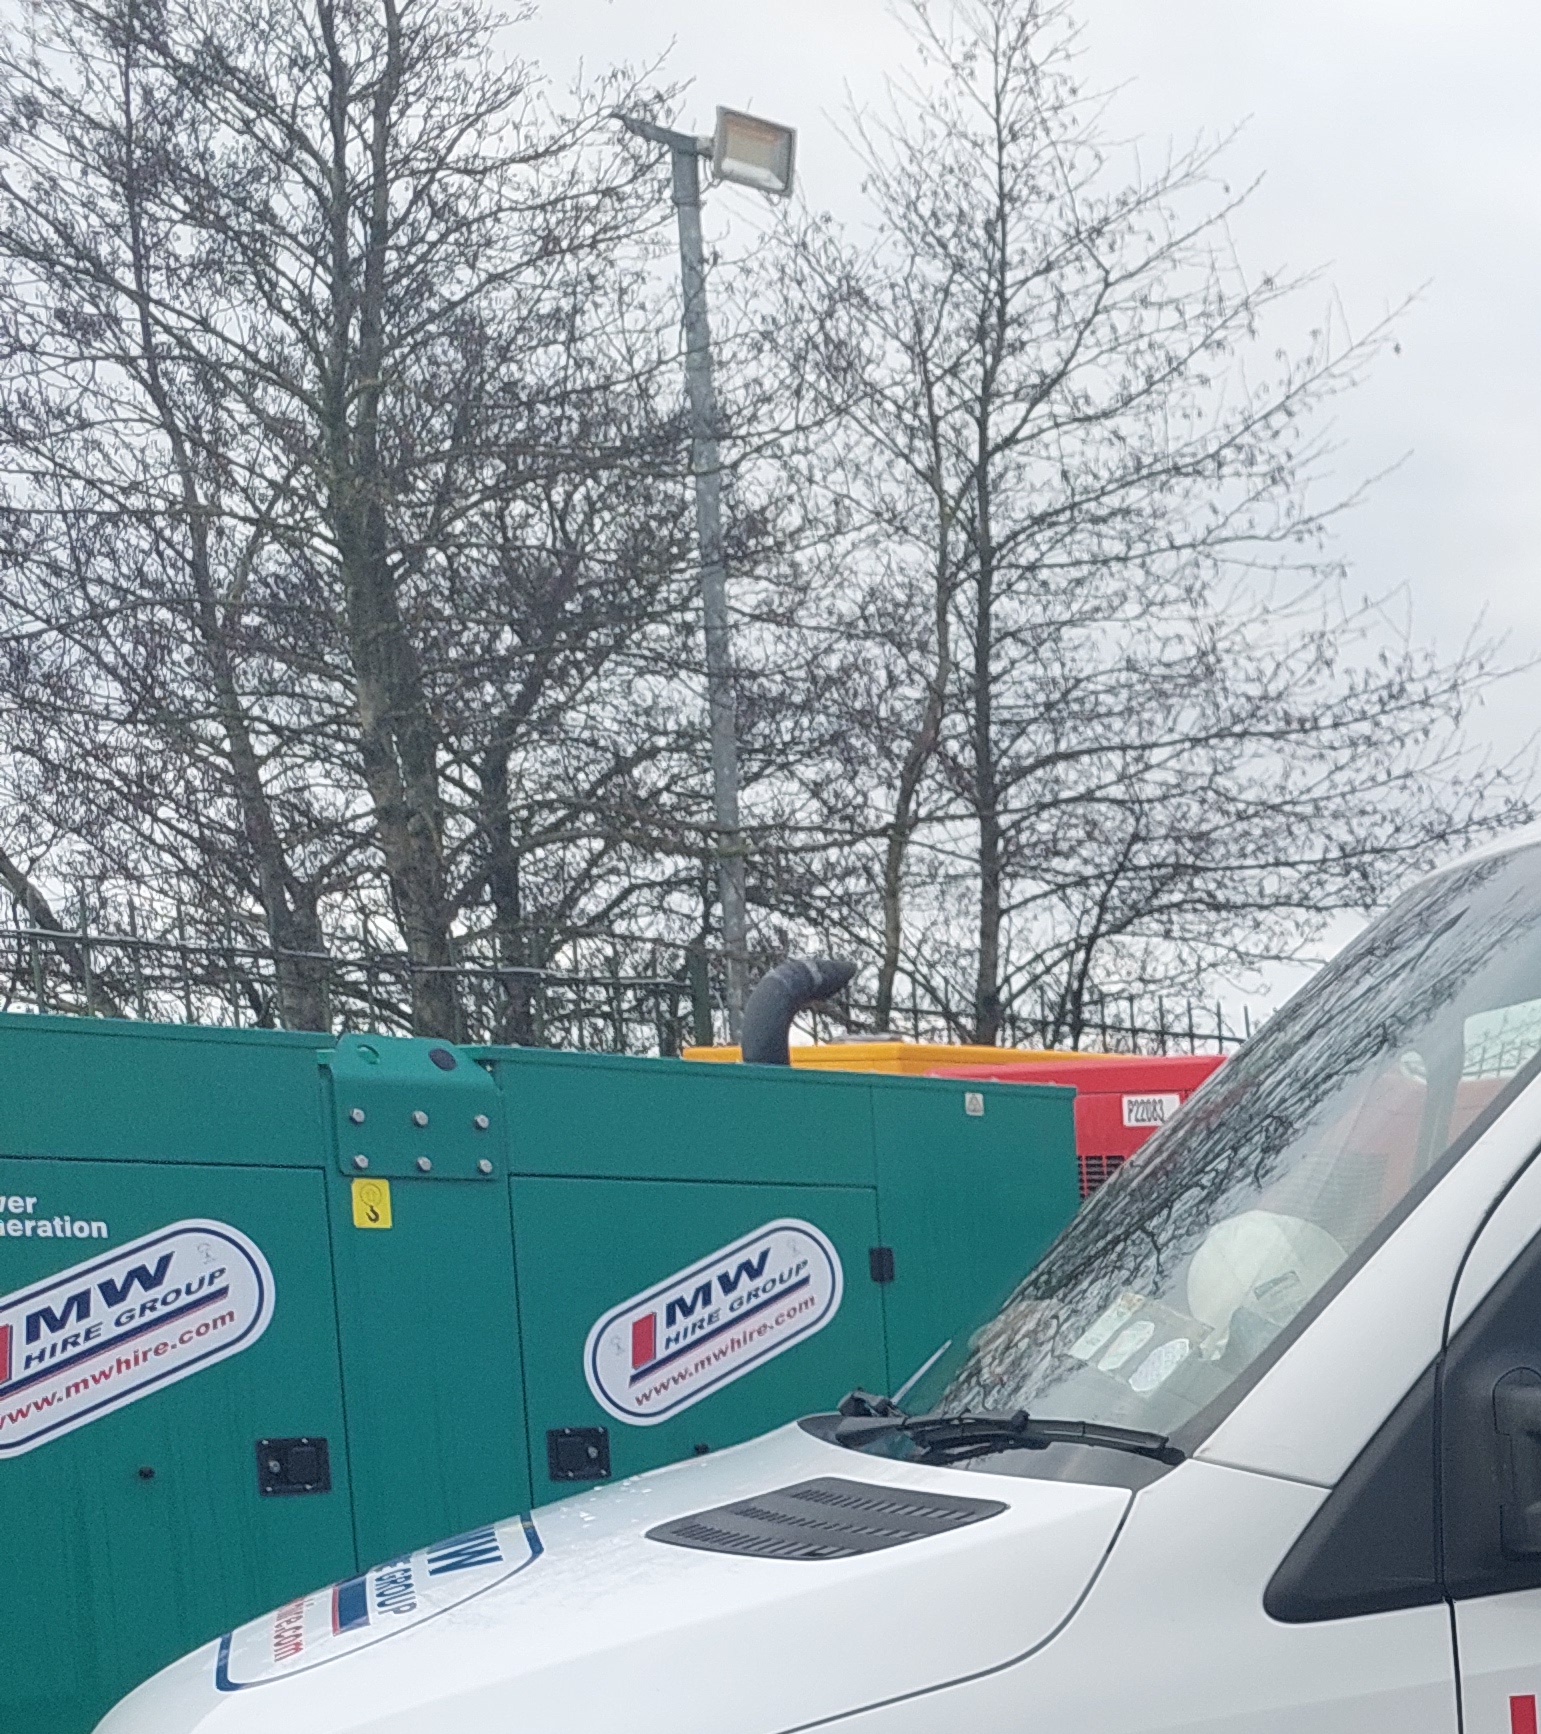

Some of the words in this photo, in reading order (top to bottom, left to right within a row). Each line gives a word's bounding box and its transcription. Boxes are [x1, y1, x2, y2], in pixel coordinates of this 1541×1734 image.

[23, 1321, 104, 1371] HIRE
[113, 1266, 227, 1328] GROUP
[25, 1250, 176, 1345] MW
[664, 1306, 722, 1351] HIRE
[728, 1258, 809, 1313] GROUP
[665, 1246, 772, 1330] MW
[0, 1309, 236, 1430] ww.mwhire.com
[634, 1294, 817, 1407] www.mwhire.com
